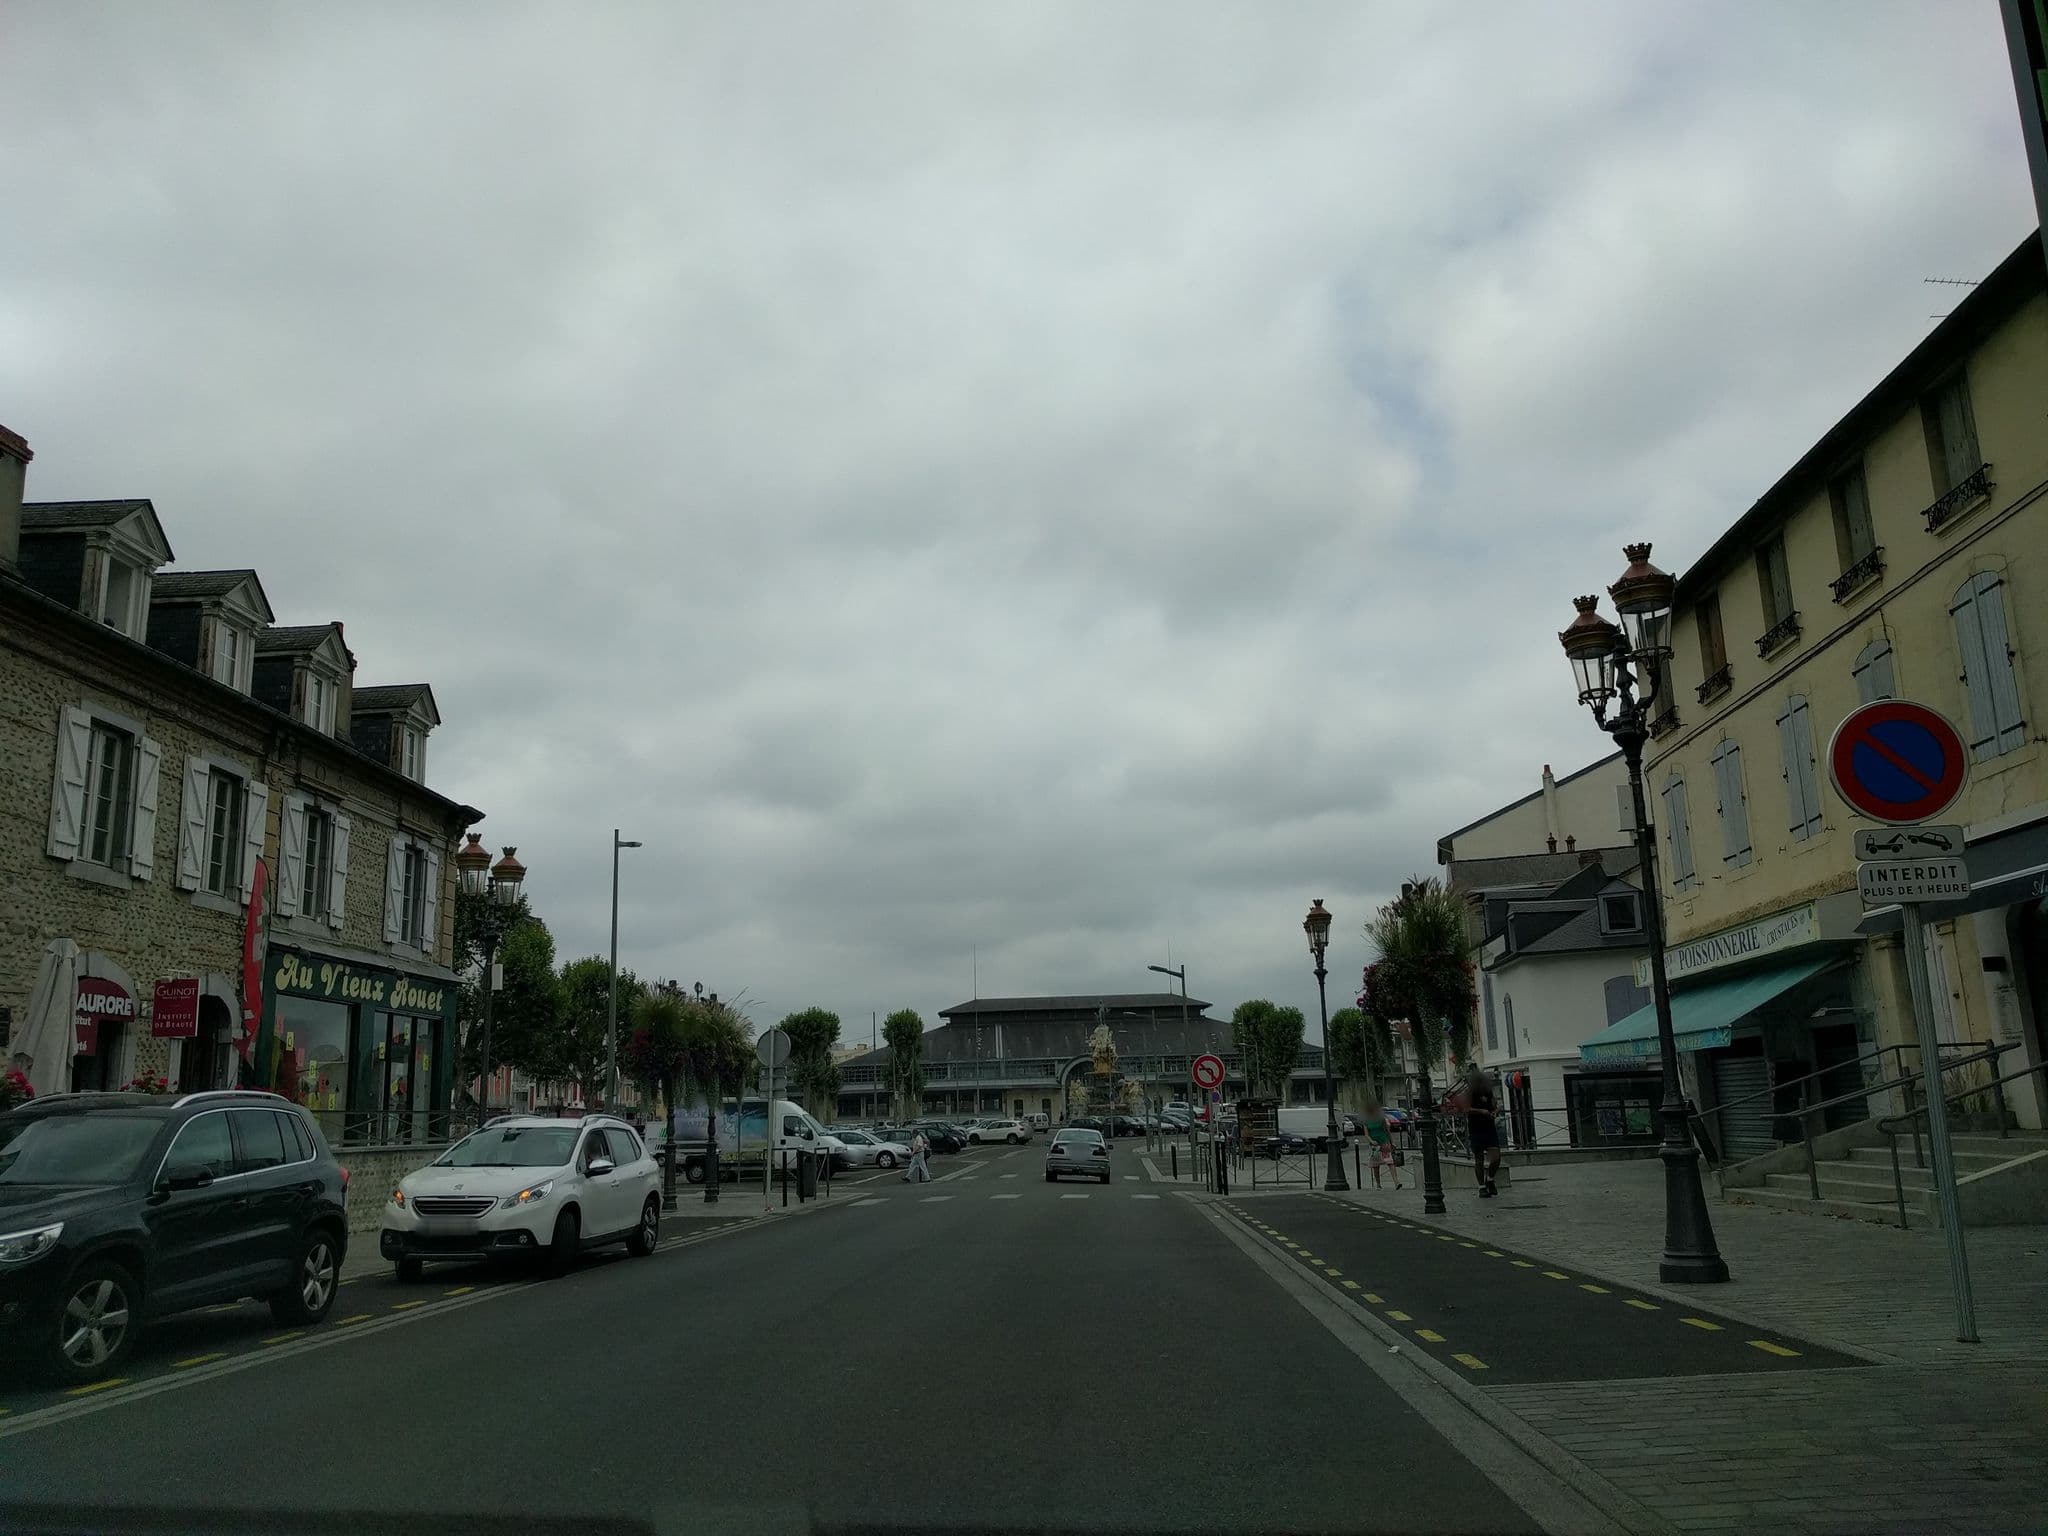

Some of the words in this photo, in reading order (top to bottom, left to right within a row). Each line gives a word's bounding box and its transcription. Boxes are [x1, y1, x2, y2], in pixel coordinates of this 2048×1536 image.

[1869, 866, 1957, 882] INTERDIT
[1864, 888, 1893, 897] PLUS
[1898, 886, 1913, 895] DE
[1918, 886, 1923, 895] 1
[1928, 883, 1968, 893] HEURE
[1679, 927, 1760, 970] POISSONNERIE
[275, 953, 314, 990] Au
[321, 962, 385, 1002] Vieux
[390, 977, 443, 1012] Rouet
[77, 993, 133, 1016] AURORE
